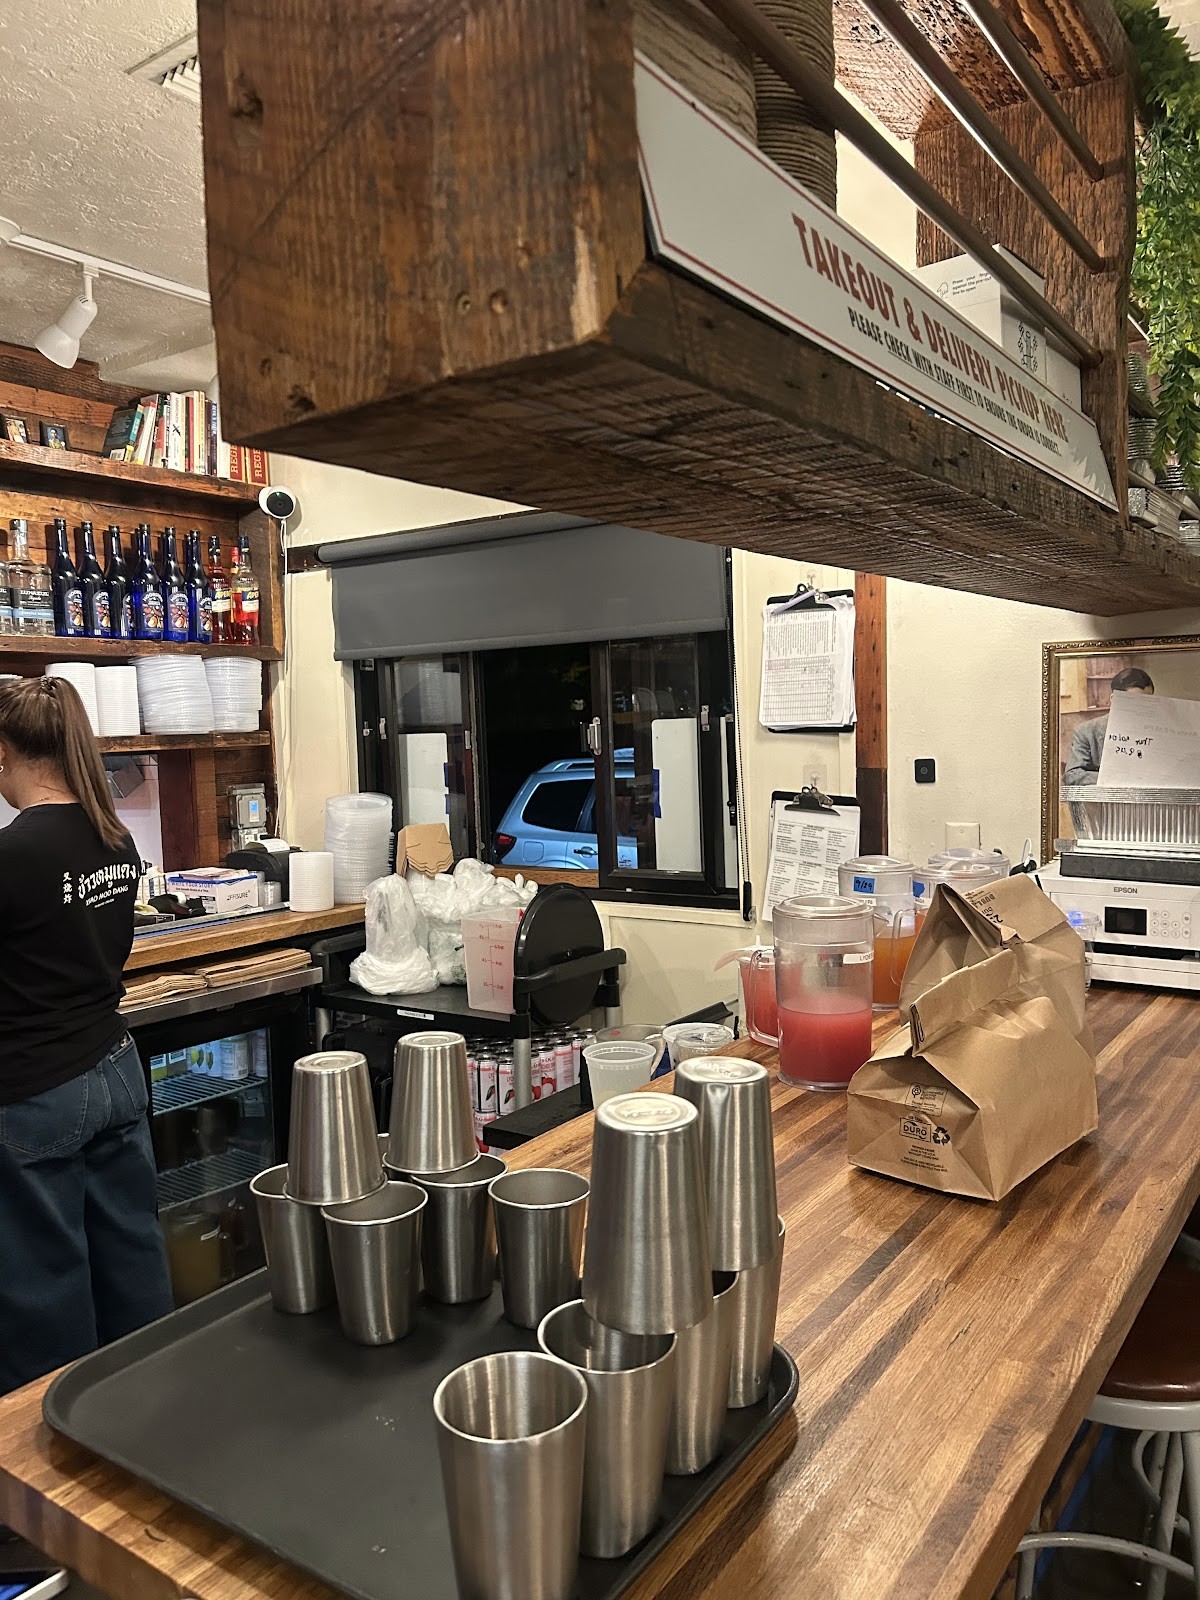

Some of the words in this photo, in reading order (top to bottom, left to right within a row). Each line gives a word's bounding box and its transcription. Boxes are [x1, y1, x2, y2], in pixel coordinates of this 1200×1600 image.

[791, 212, 900, 328] TAKEOUT
[903, 297, 924, 344] &
[921, 311, 996, 394] DELIVERY
[995, 365, 1040, 424] PICKUP
[1039, 399, 1069, 443] HERE
[847, 306, 884, 346] PLEASE
[883, 330, 913, 364] CHECK
[911, 349, 935, 378] WITH
[934, 363, 955, 391] STAFF
[954, 376, 976, 403] FIRST
[974, 390, 984, 409] TO
[983, 396, 1007, 423] ENSURE
[1005, 410, 1018, 430] THE
[1017, 418, 1035, 441] ORDER
[1034, 427, 1041, 444] IS
[98, 889, 112, 901] MOO
[112, 884, 129, 896] DANG
[1113, 886, 1138, 894] EPSON
[903, 1124, 927, 1136] DURO
